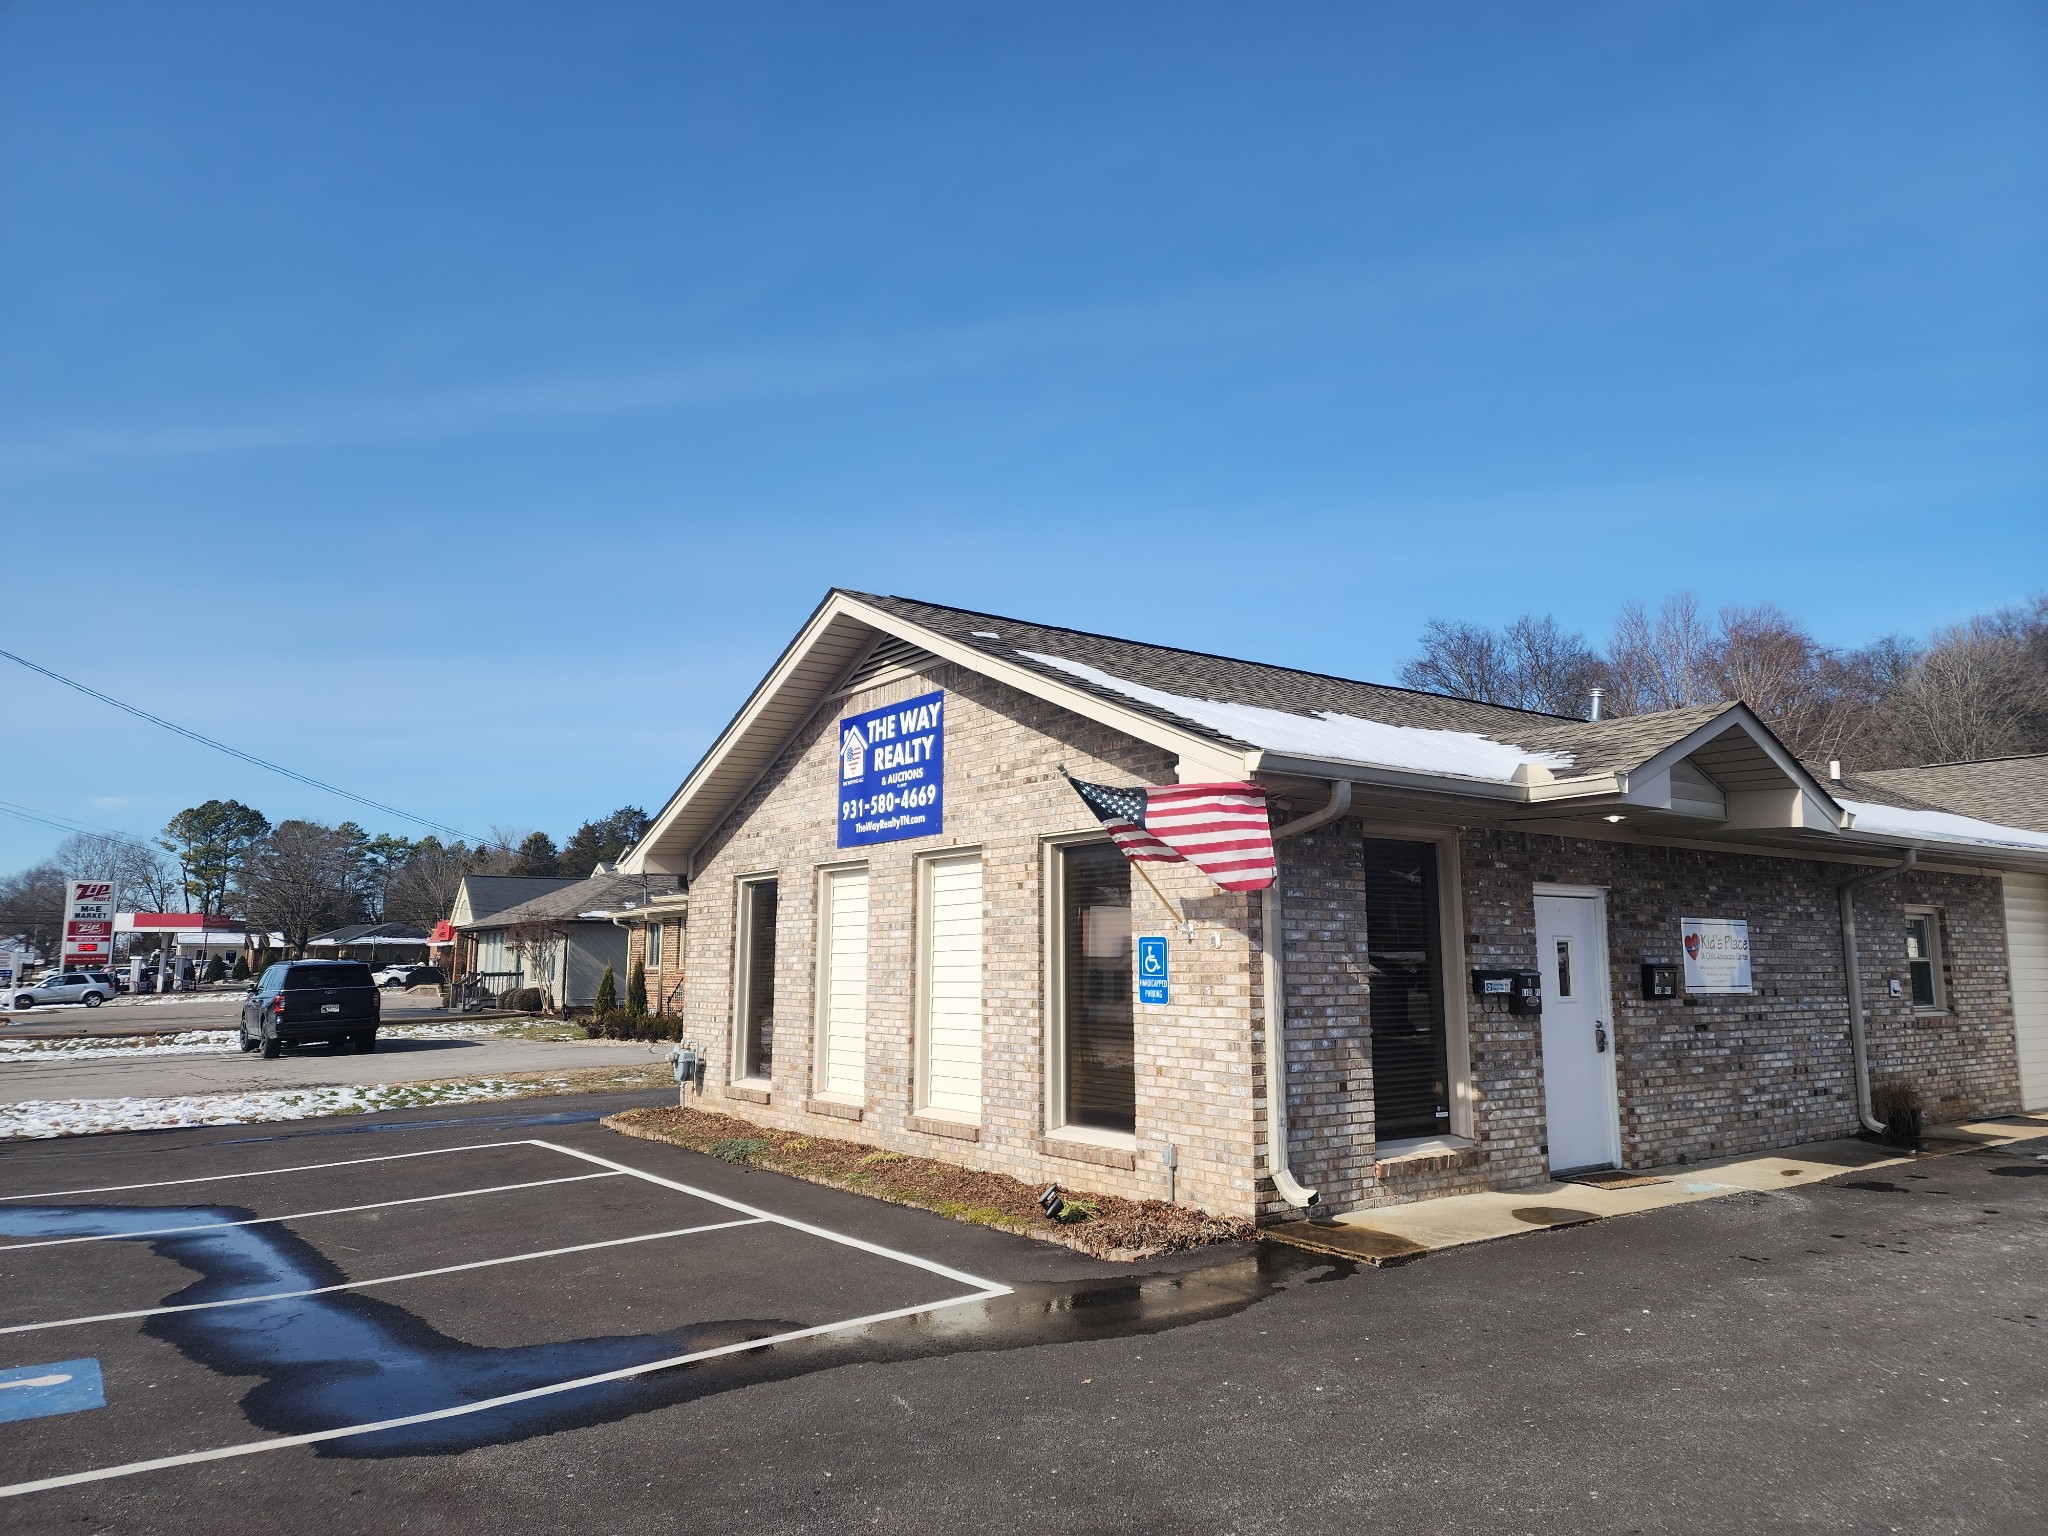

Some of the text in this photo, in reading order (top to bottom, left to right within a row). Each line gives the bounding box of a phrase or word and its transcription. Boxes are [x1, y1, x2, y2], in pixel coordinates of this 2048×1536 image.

[867, 702, 942, 743] THE WAY
[874, 735, 935, 771] REALTY
[881, 776, 887, 786] &
[887, 767, 924, 785] AUCTIONS
[842, 784, 936, 820] 931-580-4669
[855, 814, 926, 833] TheWayRealtyTN.com
[80, 905, 103, 913] M&E
[1700, 934, 1748, 951] Kid's Place
[1140, 979, 1168, 988] HANDICAPPED
[1144, 990, 1163, 998] PARKING
